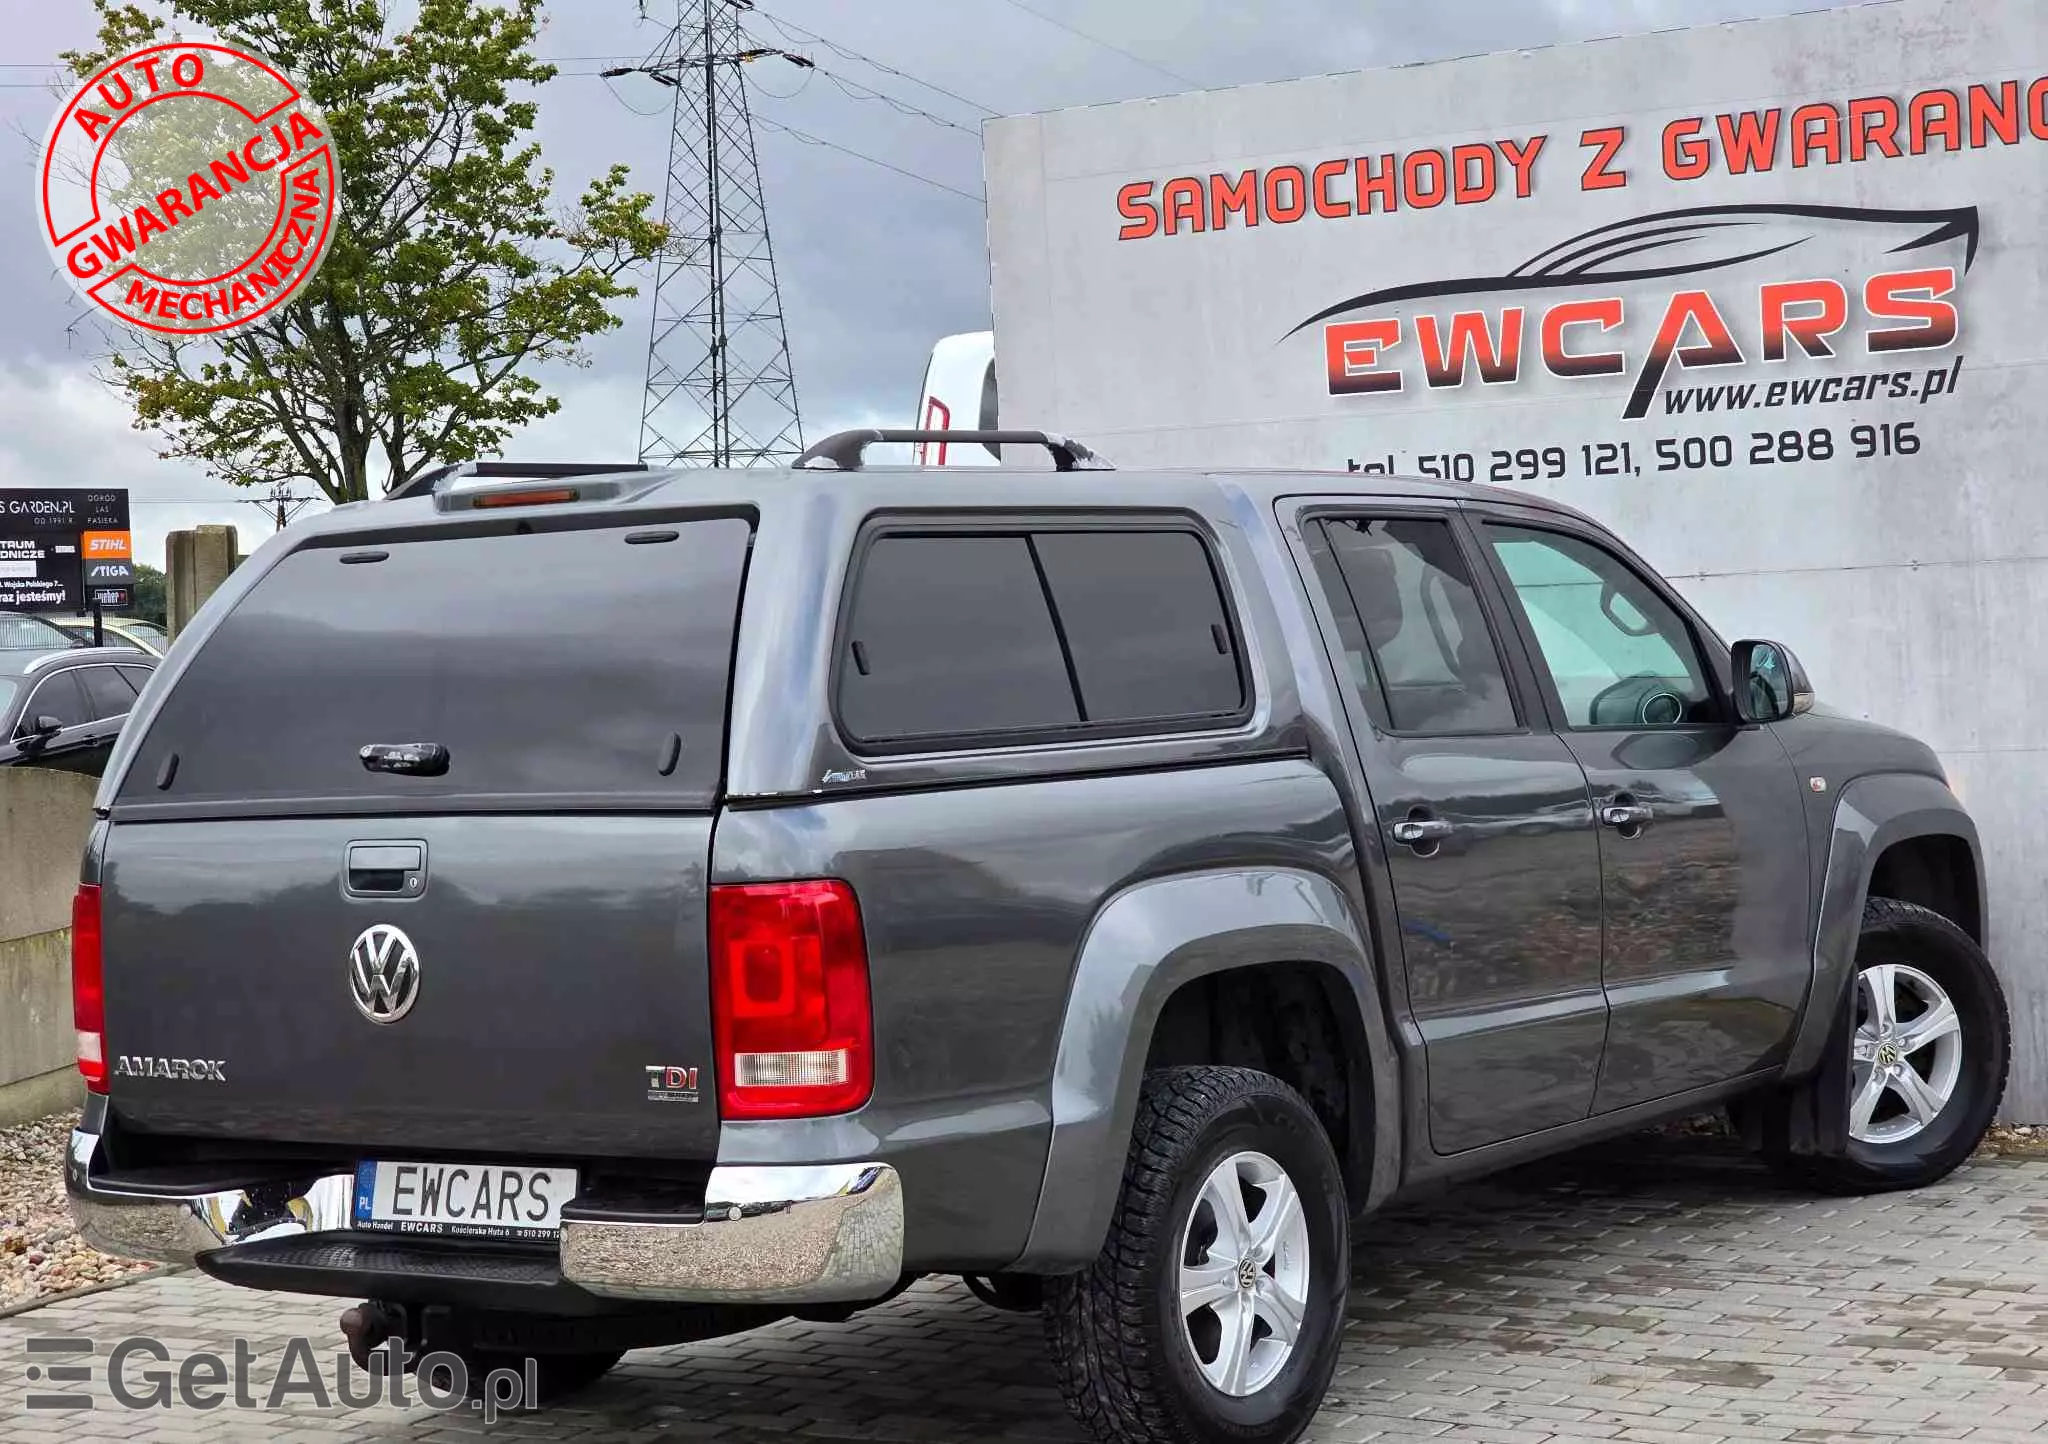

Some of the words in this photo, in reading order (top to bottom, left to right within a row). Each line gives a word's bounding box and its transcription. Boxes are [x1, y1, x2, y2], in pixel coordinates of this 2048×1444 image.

[1119, 135, 1547, 240] SAMOCHODY
[1580, 126, 1627, 191] Z
[1324, 266, 1958, 420] EWCARS
[1665, 355, 1964, 415] www.ewcars.pl
[1491, 447, 1566, 482] 299
[1582, 441, 1641, 477] 121,
[1655, 435, 1733, 471] 500
[1750, 428, 1834, 465] 288
[1850, 421, 1921, 458] 916
[9, 500, 76, 514] GARDEN.PL
[90, 539, 127, 551] STIHL
[91, 565, 128, 577] STIGA
[16, 590, 66, 605] jesteśmy!
[115, 1055, 226, 1082] AMAROK
[645, 1065, 698, 1089] TDI
[358, 1196, 372, 1210] PL
[392, 1166, 552, 1222] EWCARS
[357, 1221, 372, 1229] Auto
[400, 1221, 443, 1233] EWCARS
